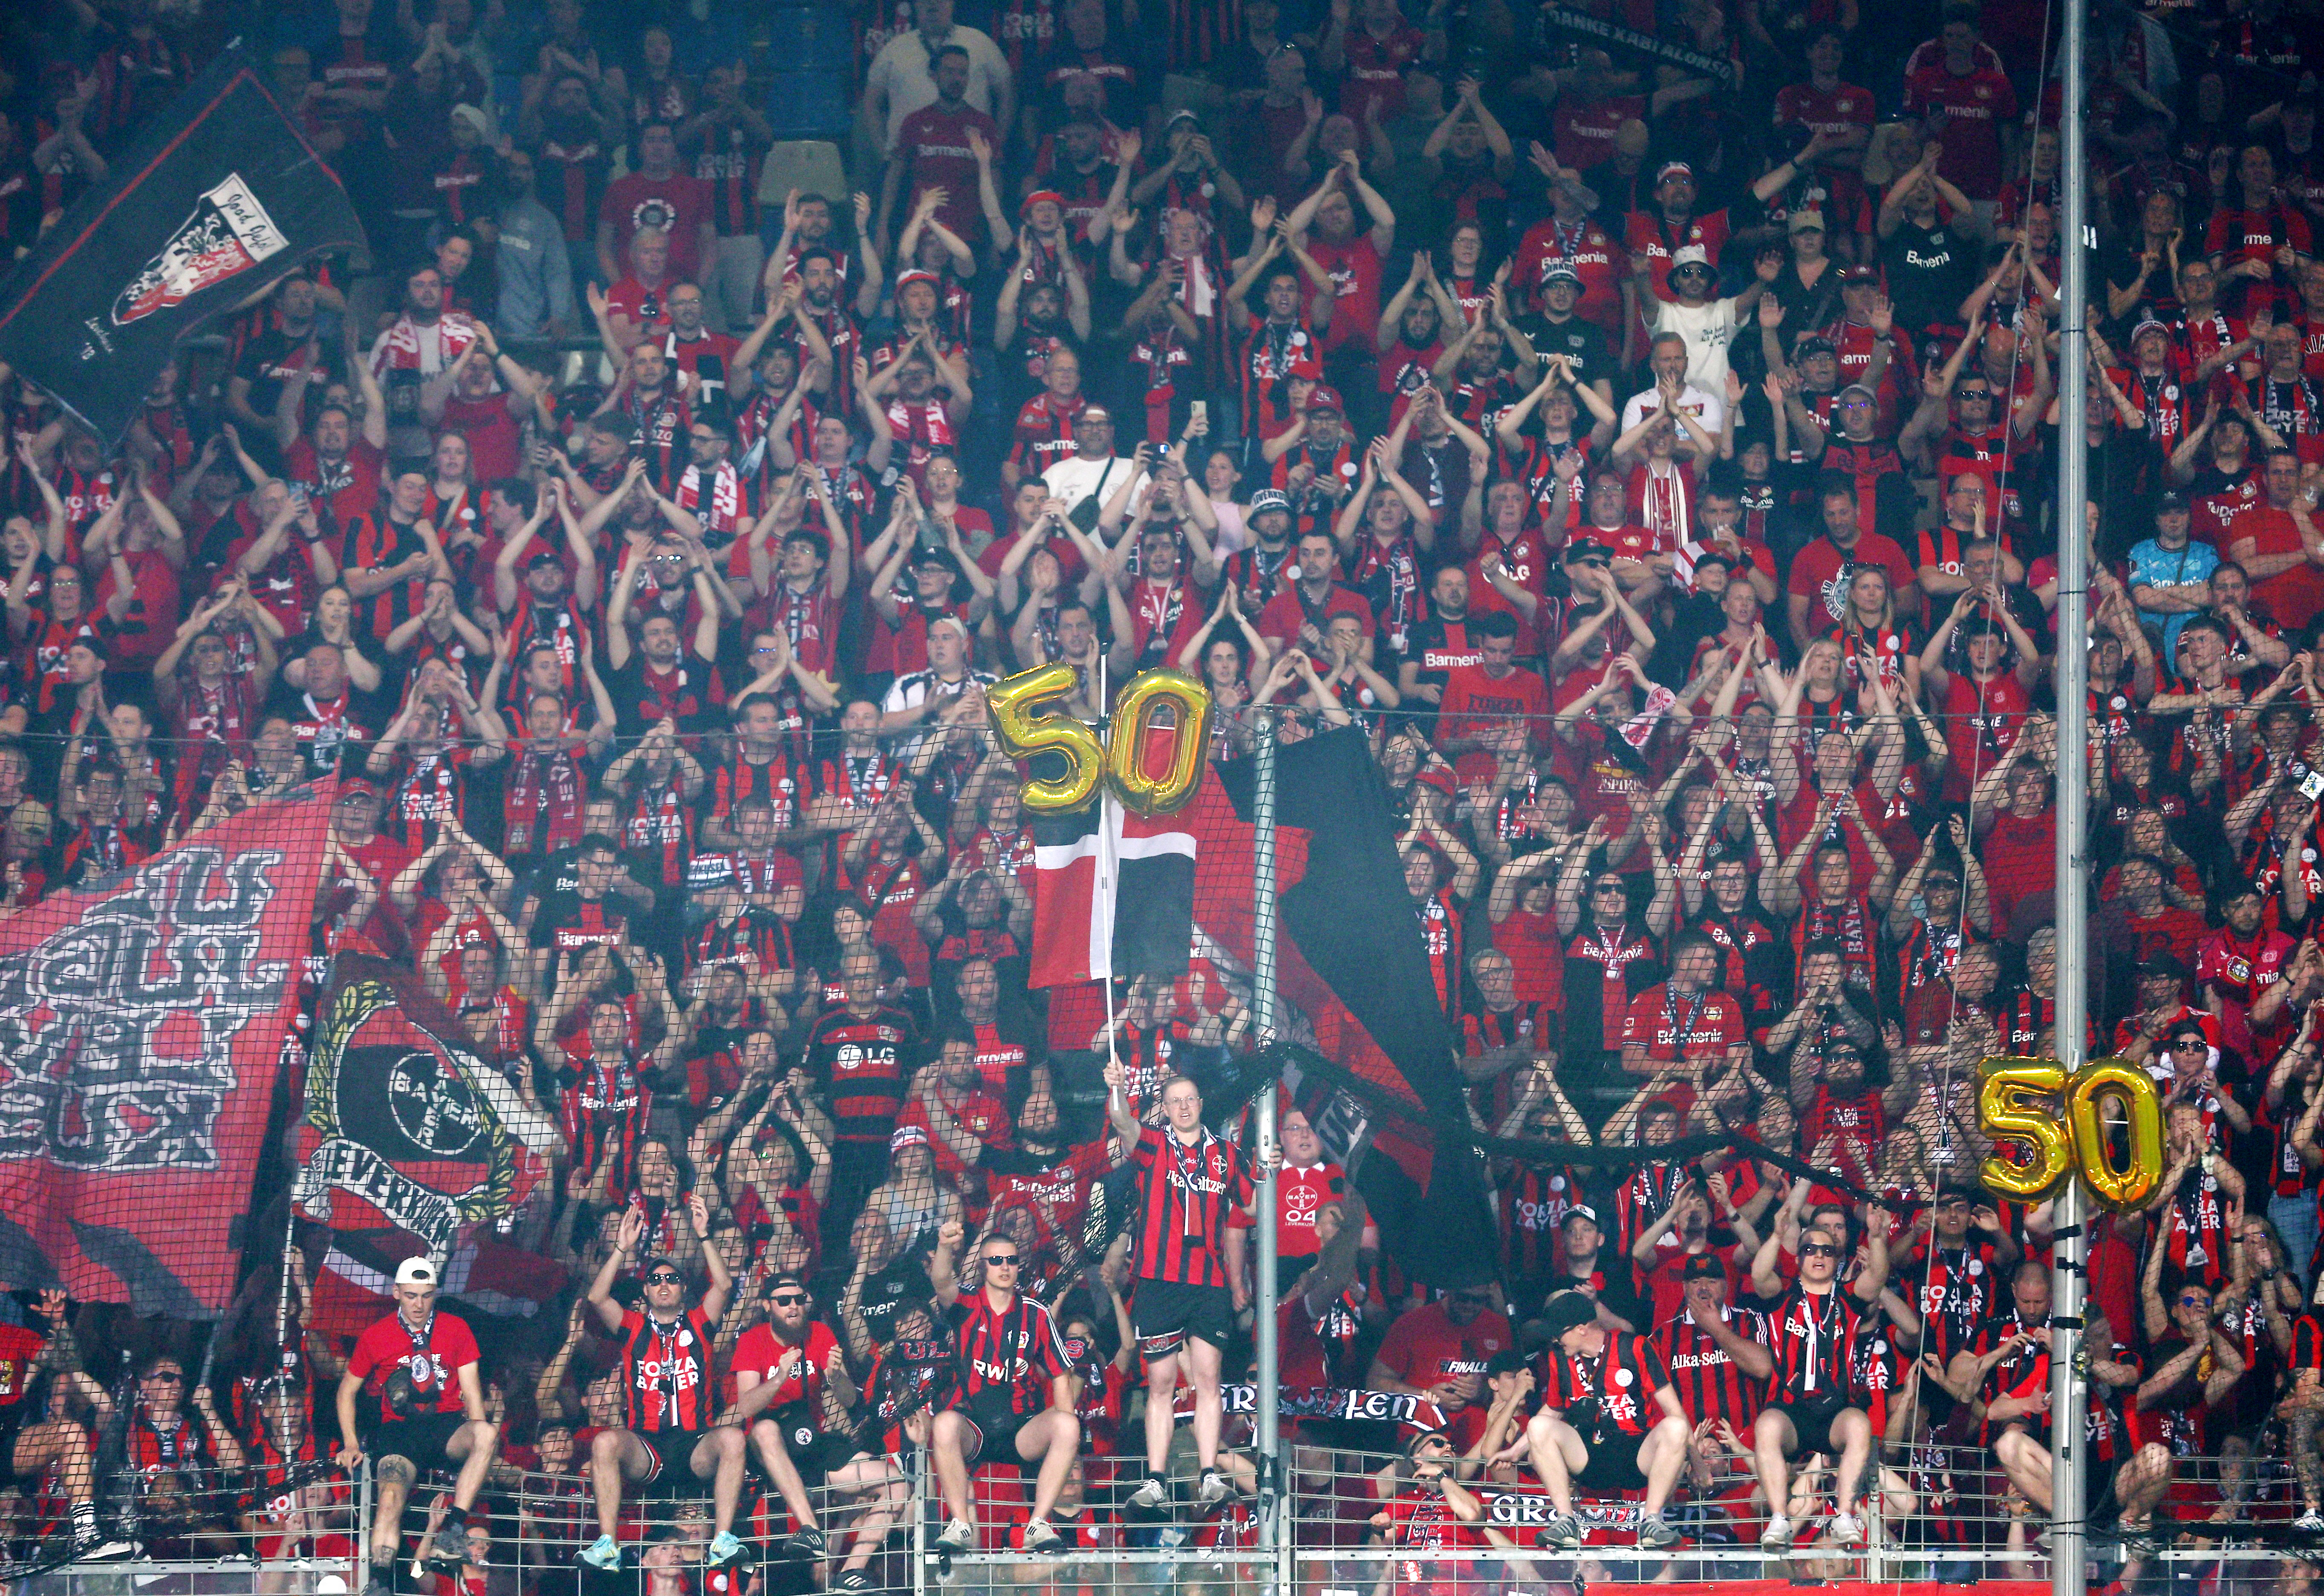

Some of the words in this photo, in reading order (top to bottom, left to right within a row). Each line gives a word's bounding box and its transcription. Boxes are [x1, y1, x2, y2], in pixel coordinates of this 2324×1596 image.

[1612, 27, 1658, 53] XABI
[1658, 43, 1732, 80] ALONSO
[1740, 495, 1774, 505] Barnia
[985, 661, 1213, 816] 50
[1583, 940, 1643, 959] Barenia
[1657, 1028, 1723, 1045] Bamenia
[867, 1047, 896, 1065] LG
[973, 1050, 1024, 1065] rmenia
[581, 1093, 639, 1111] Barenia
[1975, 1056, 2166, 1213] 50
[1286, 1210, 1316, 1222] 04
[1920, 1299, 1982, 1313] BAYR
[636, 1357, 699, 1377] FOZA
[1448, 1361, 1488, 1373] FINALE
[1671, 1349, 1731, 1369] Alka-Seltz
[636, 1371, 699, 1391] BAER
